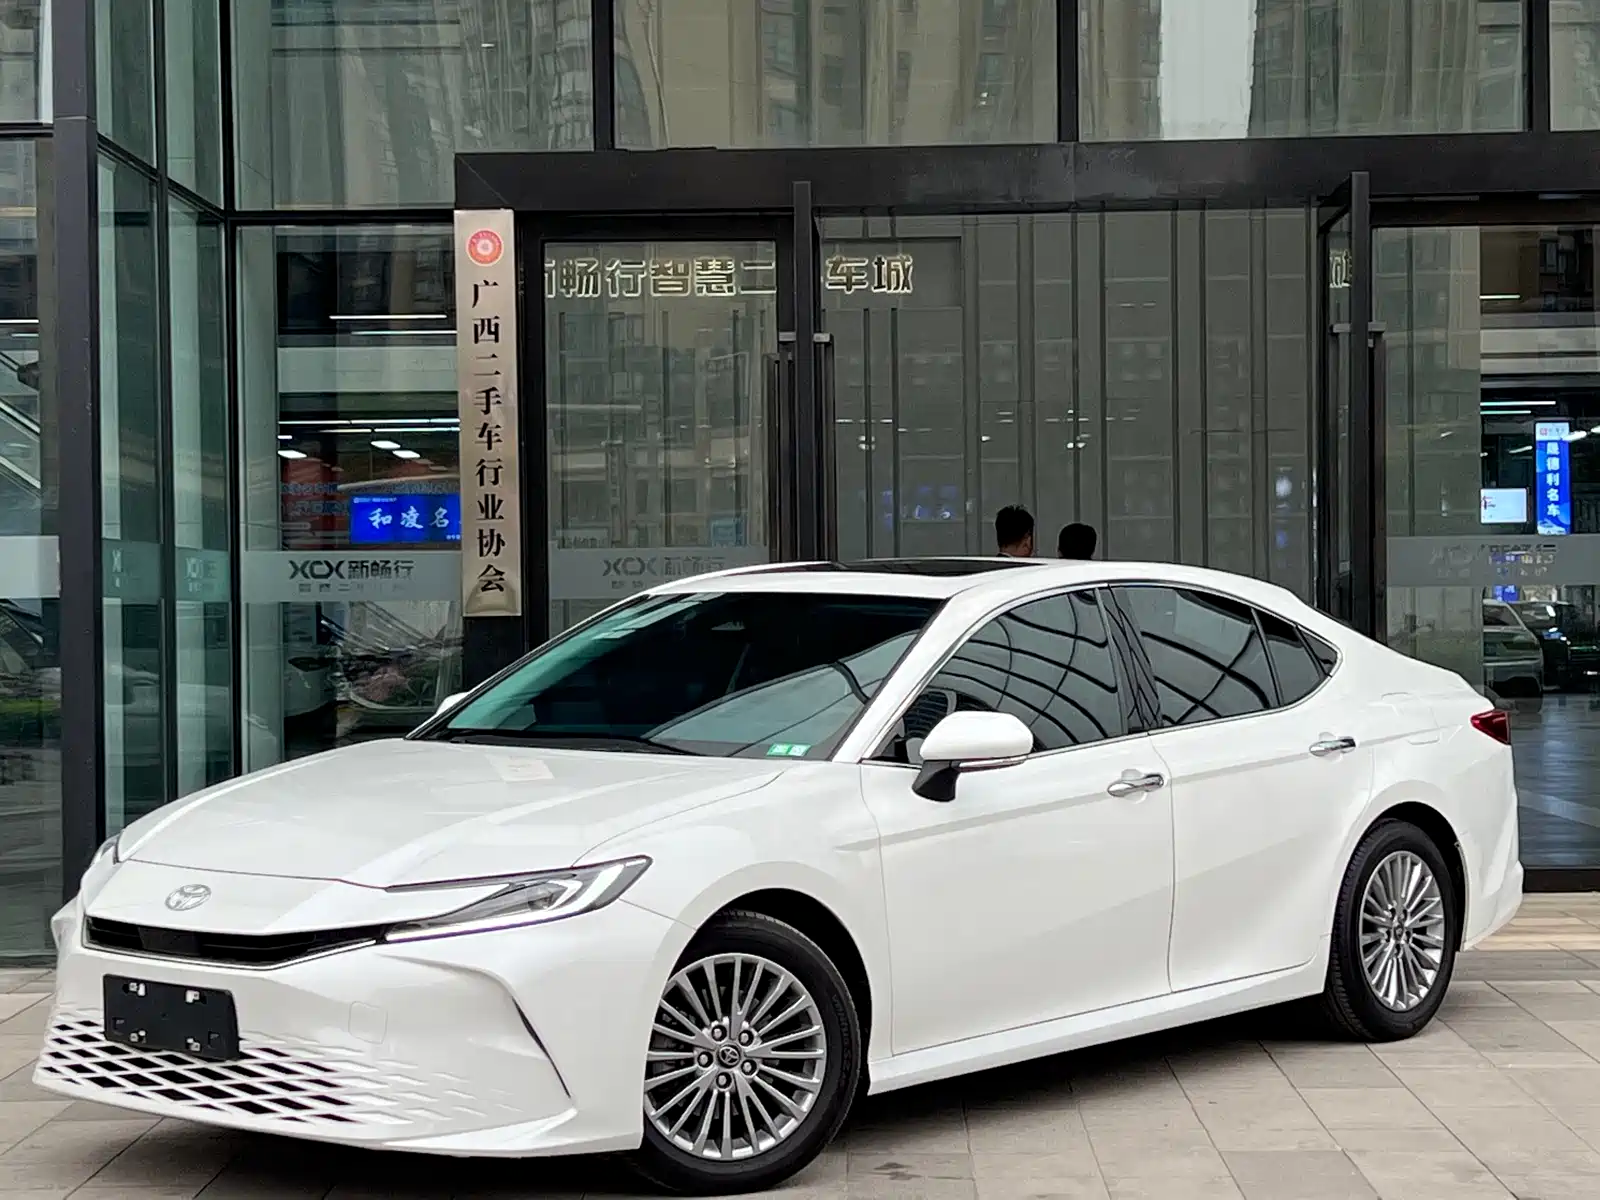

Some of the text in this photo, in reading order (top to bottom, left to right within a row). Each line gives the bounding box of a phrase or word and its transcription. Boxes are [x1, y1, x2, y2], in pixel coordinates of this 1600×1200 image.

[825, 253, 914, 294] 车城
[472, 279, 506, 593] 广西二手车行业协会
[347, 560, 415, 580] 新畅行
